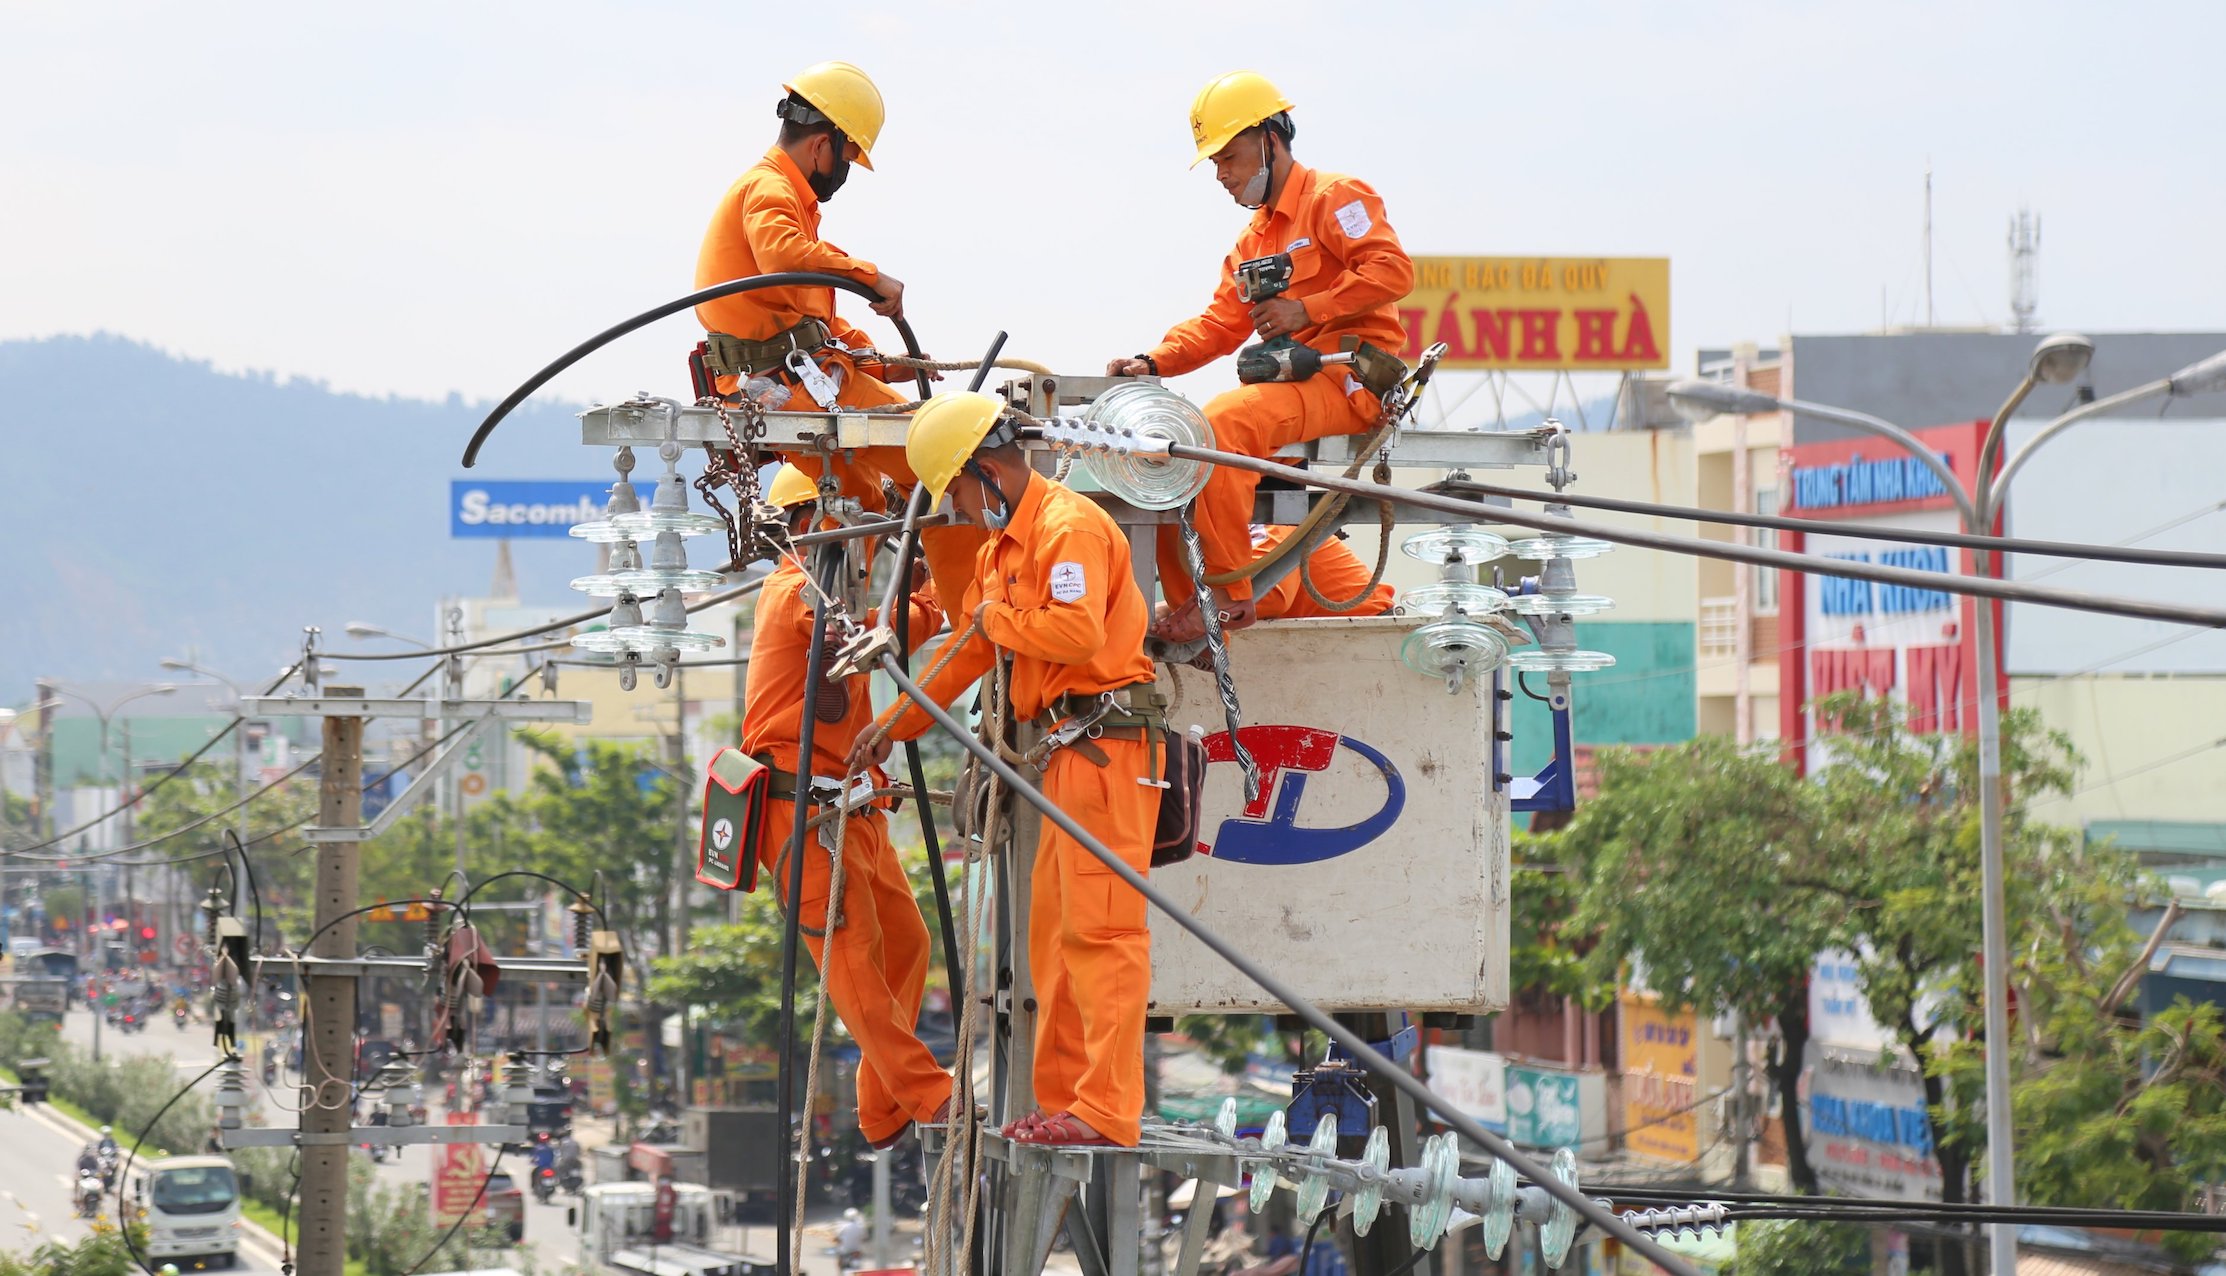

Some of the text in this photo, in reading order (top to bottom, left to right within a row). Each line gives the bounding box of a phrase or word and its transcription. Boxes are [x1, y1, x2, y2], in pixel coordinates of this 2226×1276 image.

[1400, 291, 1662, 361] HÁNH HÀ
[460, 489, 652, 526] Sacomb
[1821, 547, 1950, 616] NHA KHOA
